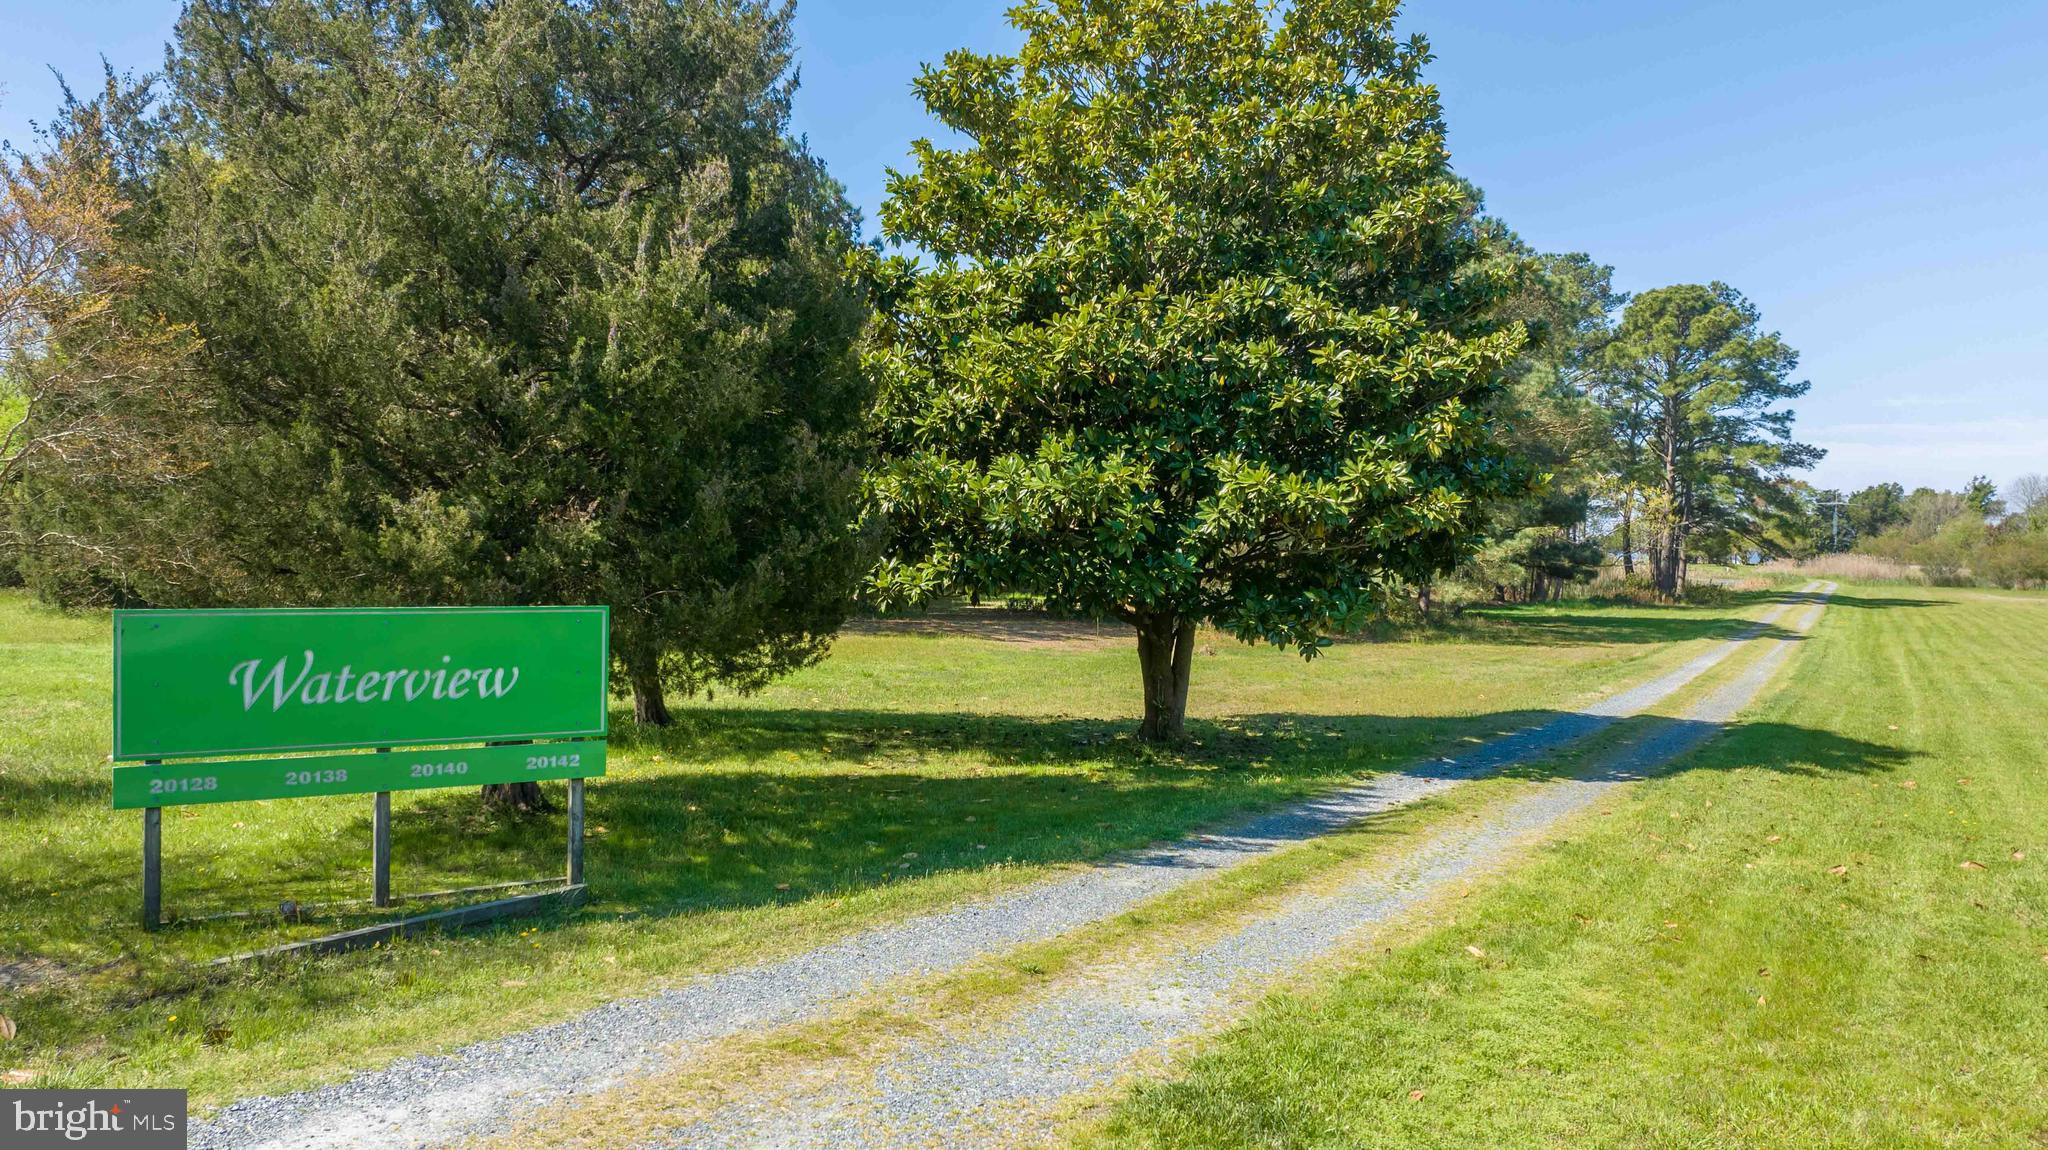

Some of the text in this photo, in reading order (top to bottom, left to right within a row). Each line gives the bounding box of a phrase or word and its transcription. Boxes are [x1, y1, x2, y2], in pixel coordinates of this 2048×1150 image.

[229, 649, 519, 713] Waterview
[149, 754, 581, 795] 20128 20138 20140 20142
